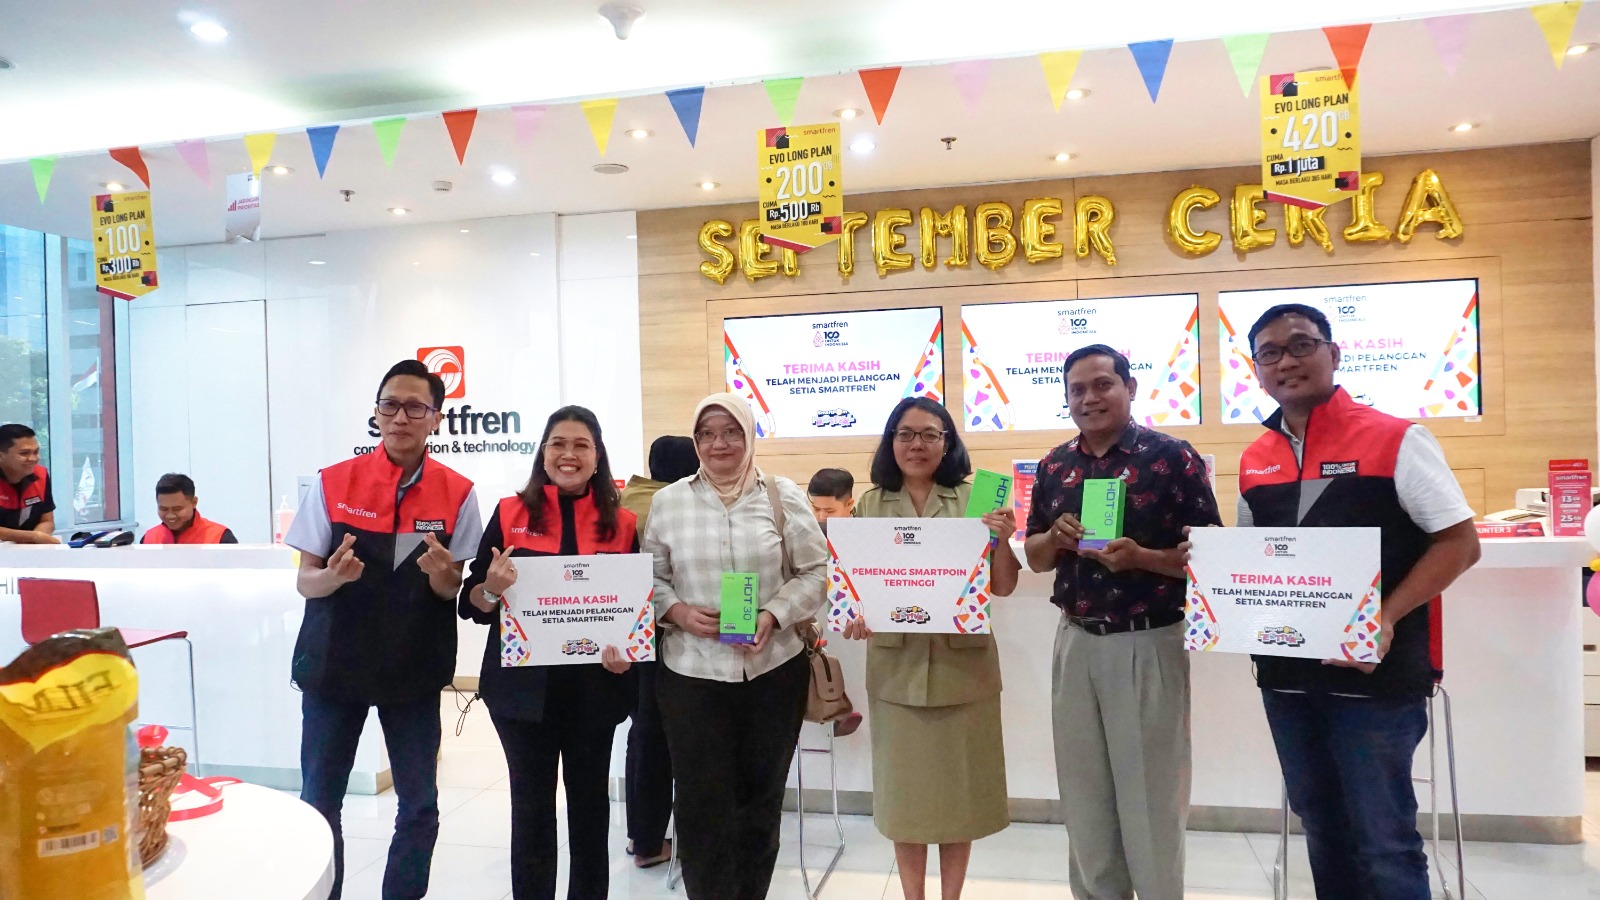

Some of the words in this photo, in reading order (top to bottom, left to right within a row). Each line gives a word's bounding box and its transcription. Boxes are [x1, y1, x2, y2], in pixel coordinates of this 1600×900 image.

[1275, 101, 1292, 113] EVO
[1296, 97, 1320, 110] LONG
[1324, 93, 1349, 105] PLAN
[803, 127, 836, 136] smartfren
[1283, 110, 1338, 152] 420
[770, 153, 784, 164] EVO
[787, 149, 808, 161] LONG
[811, 145, 832, 158] PLAN
[1266, 154, 1284, 162] CUMA
[1297, 157, 1318, 176] juta
[776, 161, 823, 200] 200
[100, 215, 111, 225] EVO
[113, 212, 128, 223] LONG
[129, 210, 145, 221] PLAN
[780, 200, 808, 222] 500
[810, 203, 820, 212] Rb
[105, 223, 141, 256] 100
[109, 255, 132, 275] 300
[1324, 294, 1367, 303] smartfren
[1057, 307, 1097, 316] smartfren
[812, 320, 849, 329] smartfren
[823, 330, 840, 339] 100
[1354, 337, 1403, 349] KASIH
[1026, 351, 1070, 364] TERIM
[1358, 351, 1426, 362] PELANGGAN
[783, 363, 835, 375] TERIMA
[838, 360, 881, 373] KASIH
[1006, 366, 1039, 376] TELAH
[1338, 363, 1398, 373] MARTFREN
[766, 377, 796, 386] TELAH
[798, 375, 840, 385] MENJADI
[841, 373, 901, 383] PELANGGAN
[1032, 377, 1061, 385] SETIA
[790, 386, 816, 395] SETIA
[818, 384, 876, 394] SMARTFREN
[452, 442, 462, 453] &
[464, 438, 536, 455] technology
[1246, 464, 1281, 476] smartfren
[995, 478, 1009, 507] HOT
[1106, 481, 1116, 509] HOT
[337, 502, 377, 519] smartfren
[1104, 511, 1114, 526] 30
[1476, 526, 1505, 534] UNTER
[852, 567, 906, 576] PEMENANG
[909, 568, 967, 576] SMARTPOIN
[884, 579, 934, 587] TERTINGGI
[1231, 573, 1283, 585] TERIMA
[1286, 576, 1331, 586] KASIH
[743, 576, 753, 604] HOT
[1212, 587, 1243, 596] TELAH
[1245, 589, 1288, 598] MENJADI
[1289, 591, 1353, 600] PELANGGAN
[537, 596, 580, 606] TERIMA
[583, 595, 618, 604] KASIH
[1235, 598, 1263, 606] SETIA
[1265, 599, 1326, 608] SMARTFREN
[586, 607, 634, 615] PELANGGAN
[743, 606, 752, 621] 30
[567, 616, 615, 624] SMARTFREN
